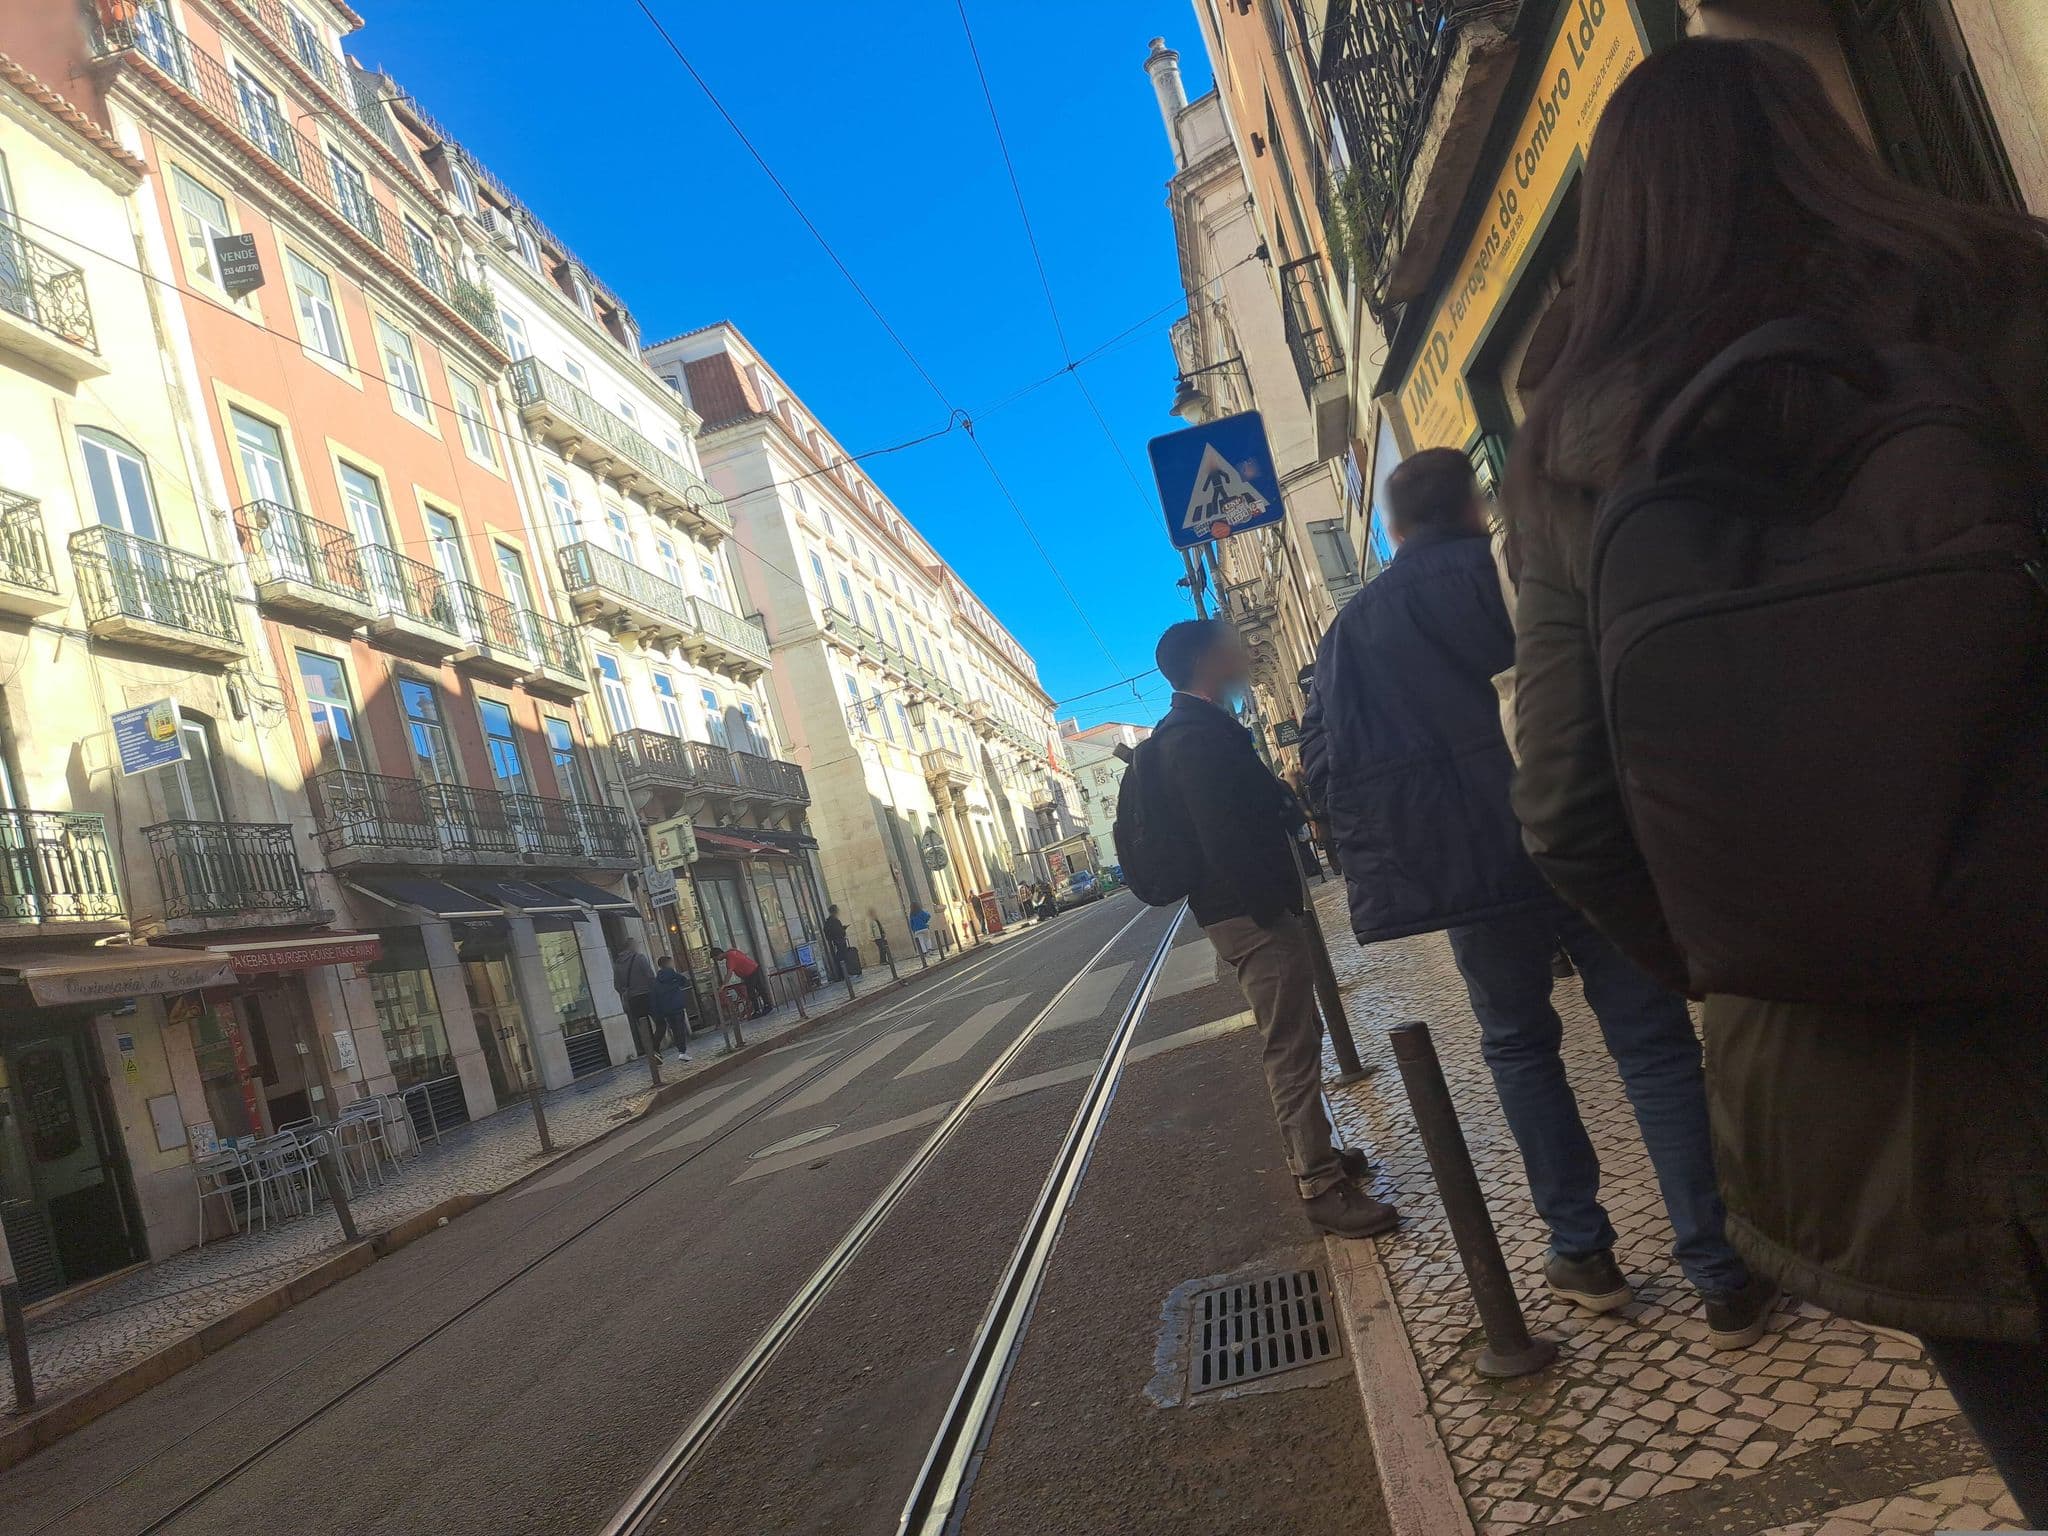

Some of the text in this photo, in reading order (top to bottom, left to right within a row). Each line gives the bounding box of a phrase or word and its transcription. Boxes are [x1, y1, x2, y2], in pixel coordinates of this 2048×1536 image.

[1407, 330, 1450, 427] JMTD
[1448, 224, 1500, 330] Ferragens
[1499, 188, 1518, 229] do
[1514, 68, 1571, 189] Combro
[1567, 0, 1606, 71] Lda
[220, 249, 256, 262] VENDE
[242, 953, 269, 968] KEBAB
[269, 953, 277, 965] &
[276, 950, 309, 965] BURGER
[308, 948, 337, 962] HOUSE
